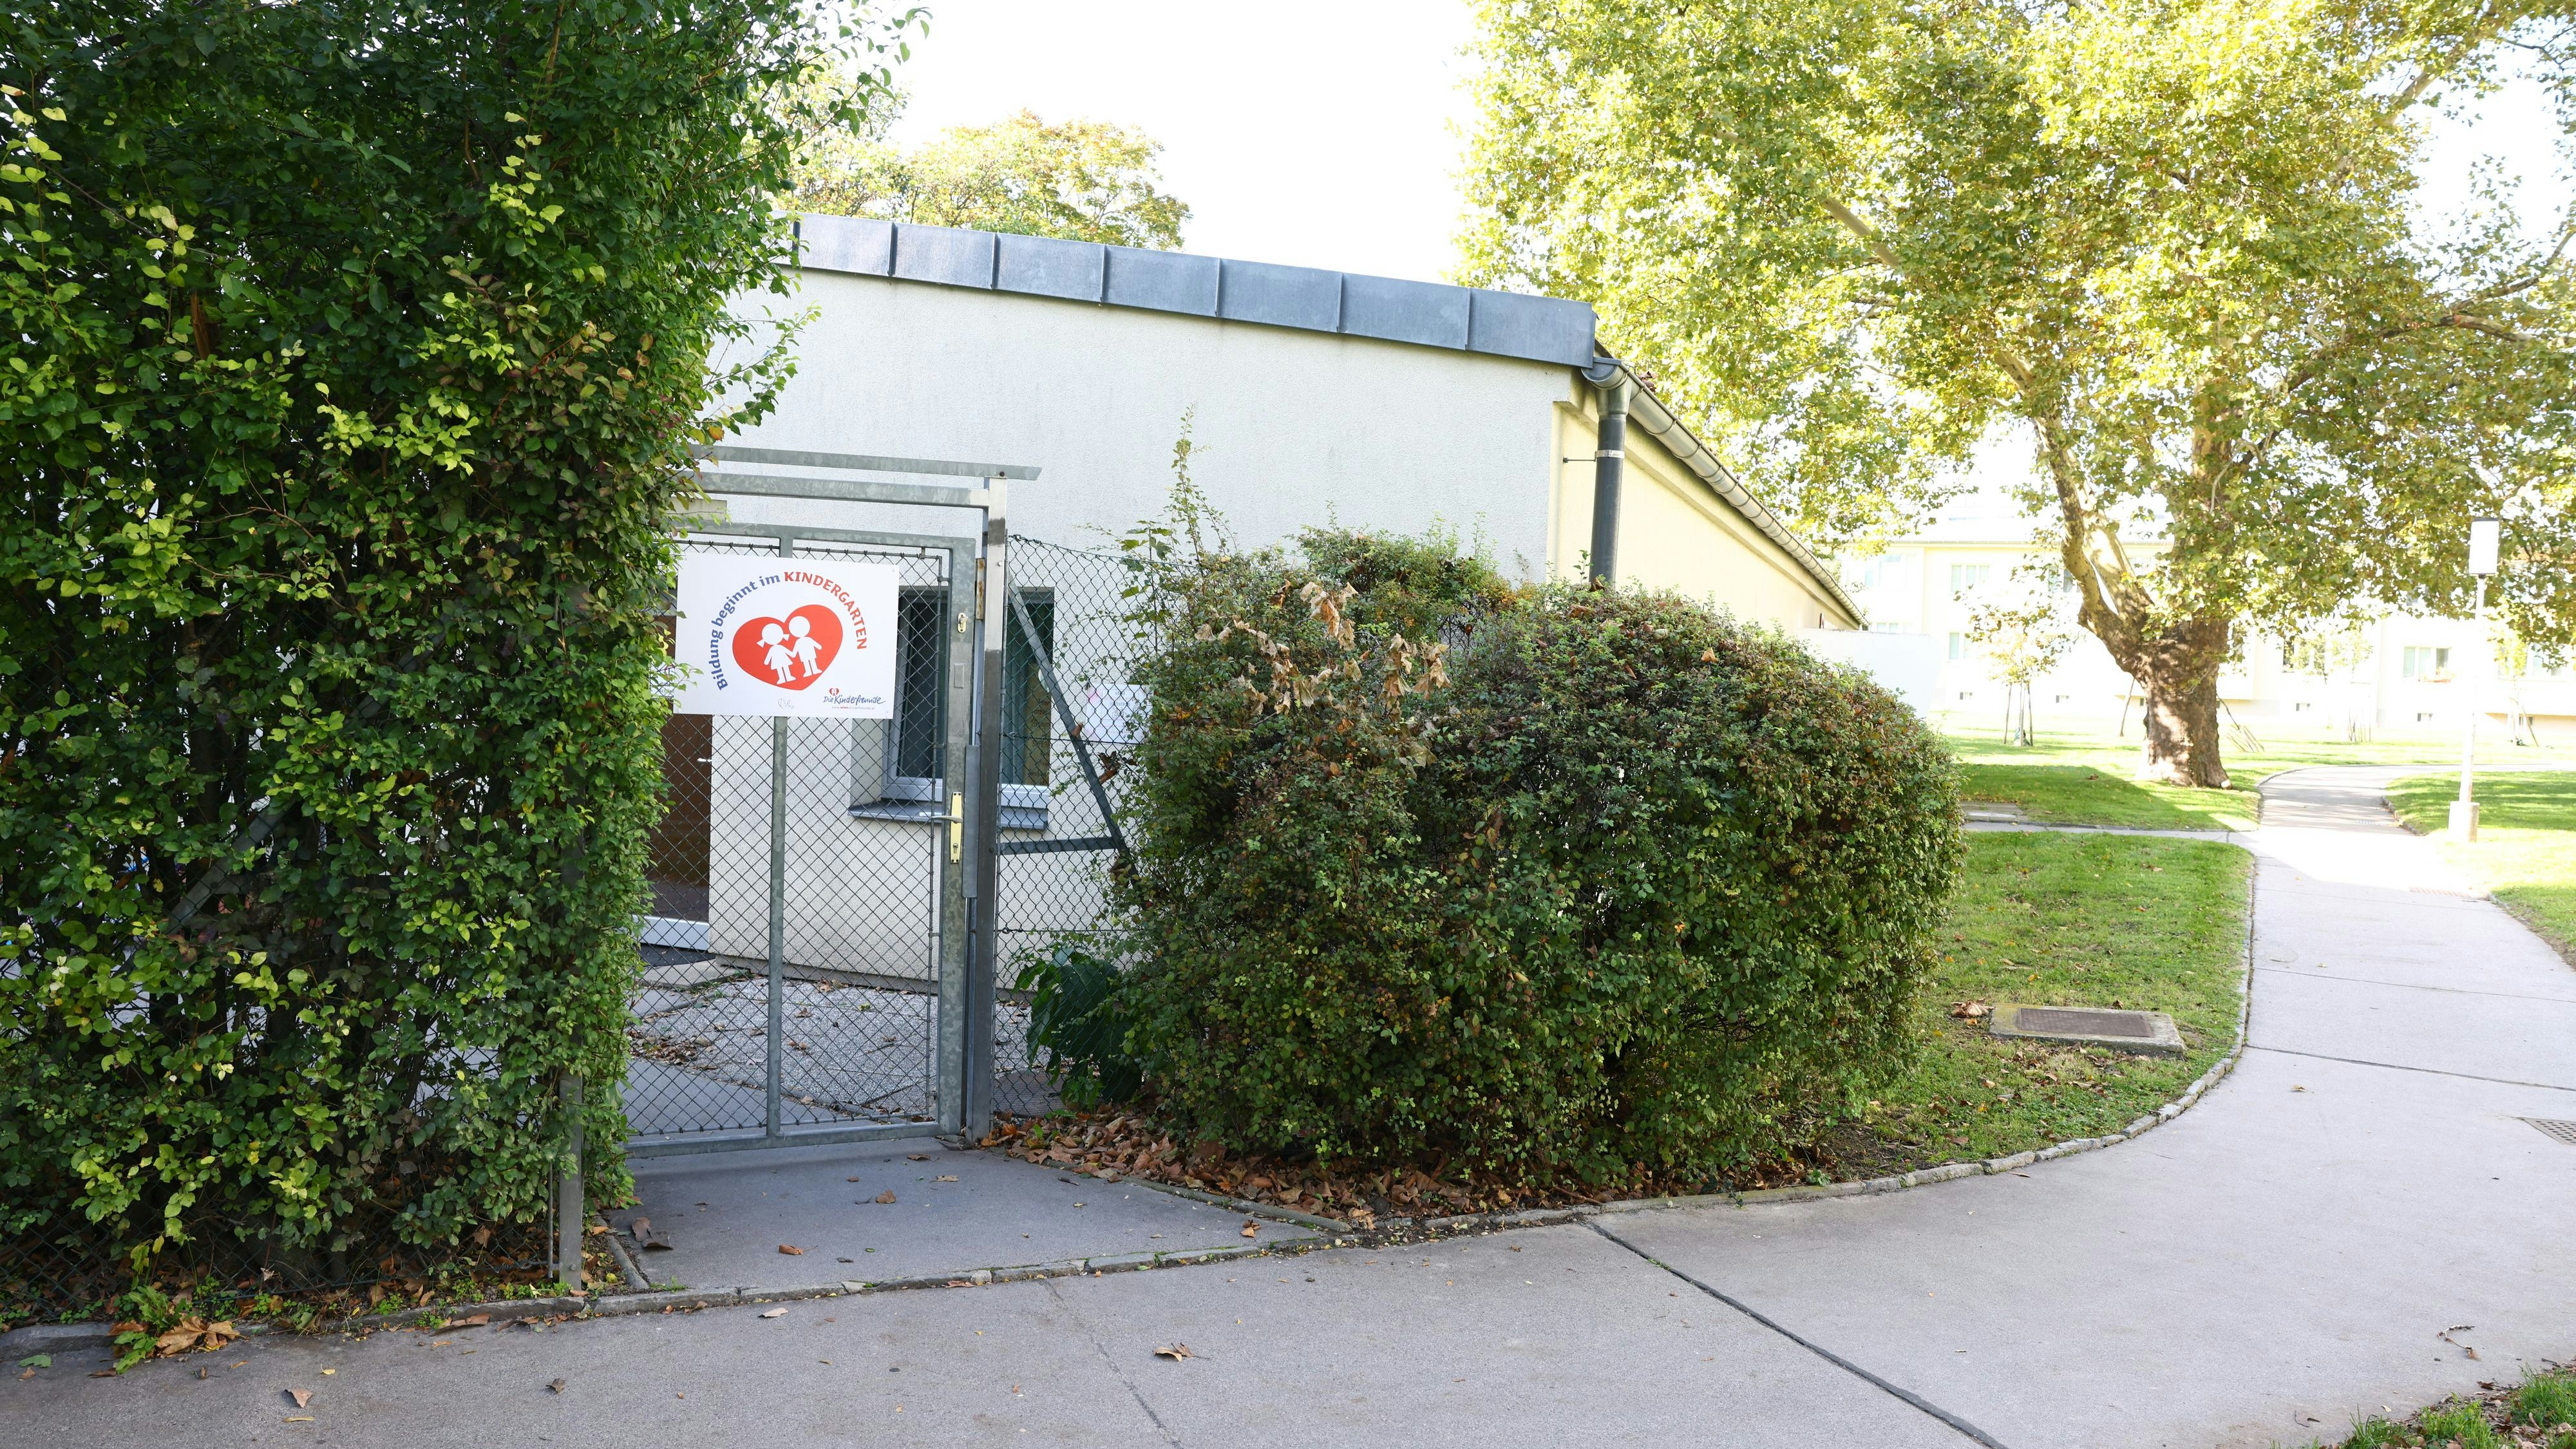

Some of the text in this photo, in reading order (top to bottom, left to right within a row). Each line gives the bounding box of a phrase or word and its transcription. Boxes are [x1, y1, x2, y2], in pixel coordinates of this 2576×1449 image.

[708, 571, 867, 690] Bildung beginnt im KINDERGARTEN
[833, 695, 887, 706] Kinderfreunde
